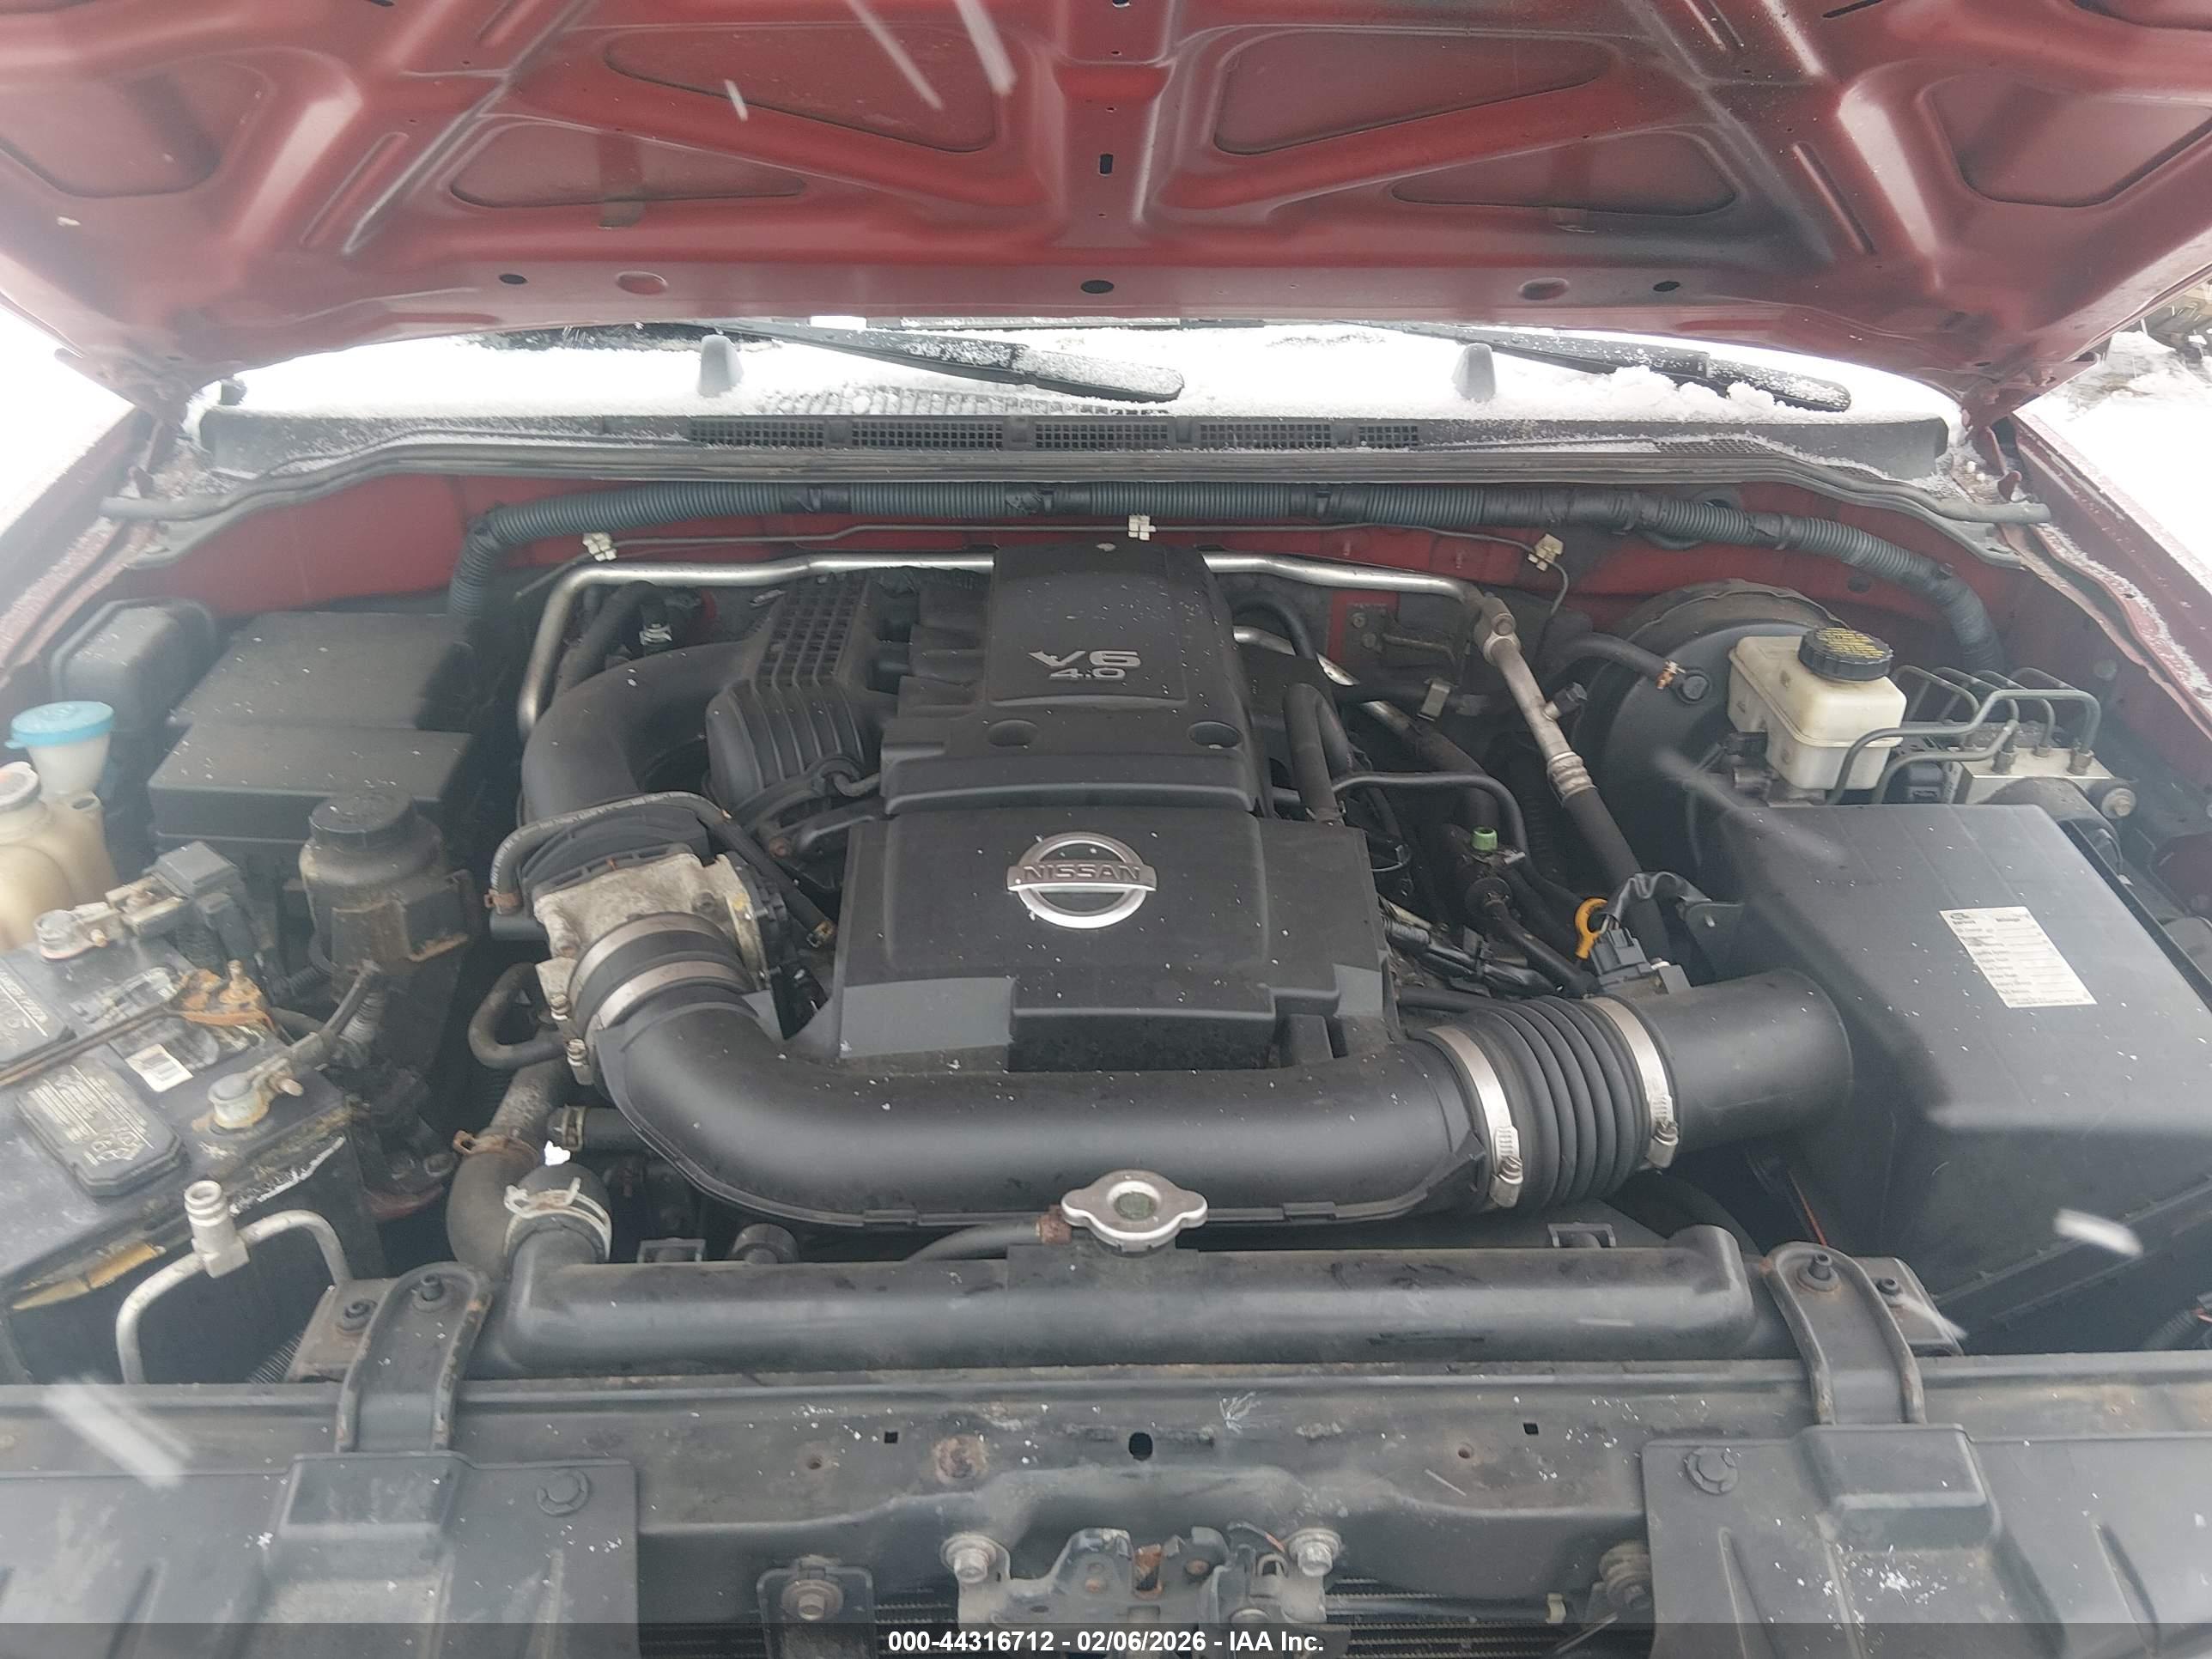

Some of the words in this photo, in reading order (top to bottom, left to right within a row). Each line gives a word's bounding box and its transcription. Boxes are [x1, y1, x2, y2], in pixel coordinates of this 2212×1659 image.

[1028, 650, 1141, 667] V6
[1049, 667, 1126, 680] 4.0
[1022, 863, 1141, 880] NISSAN
